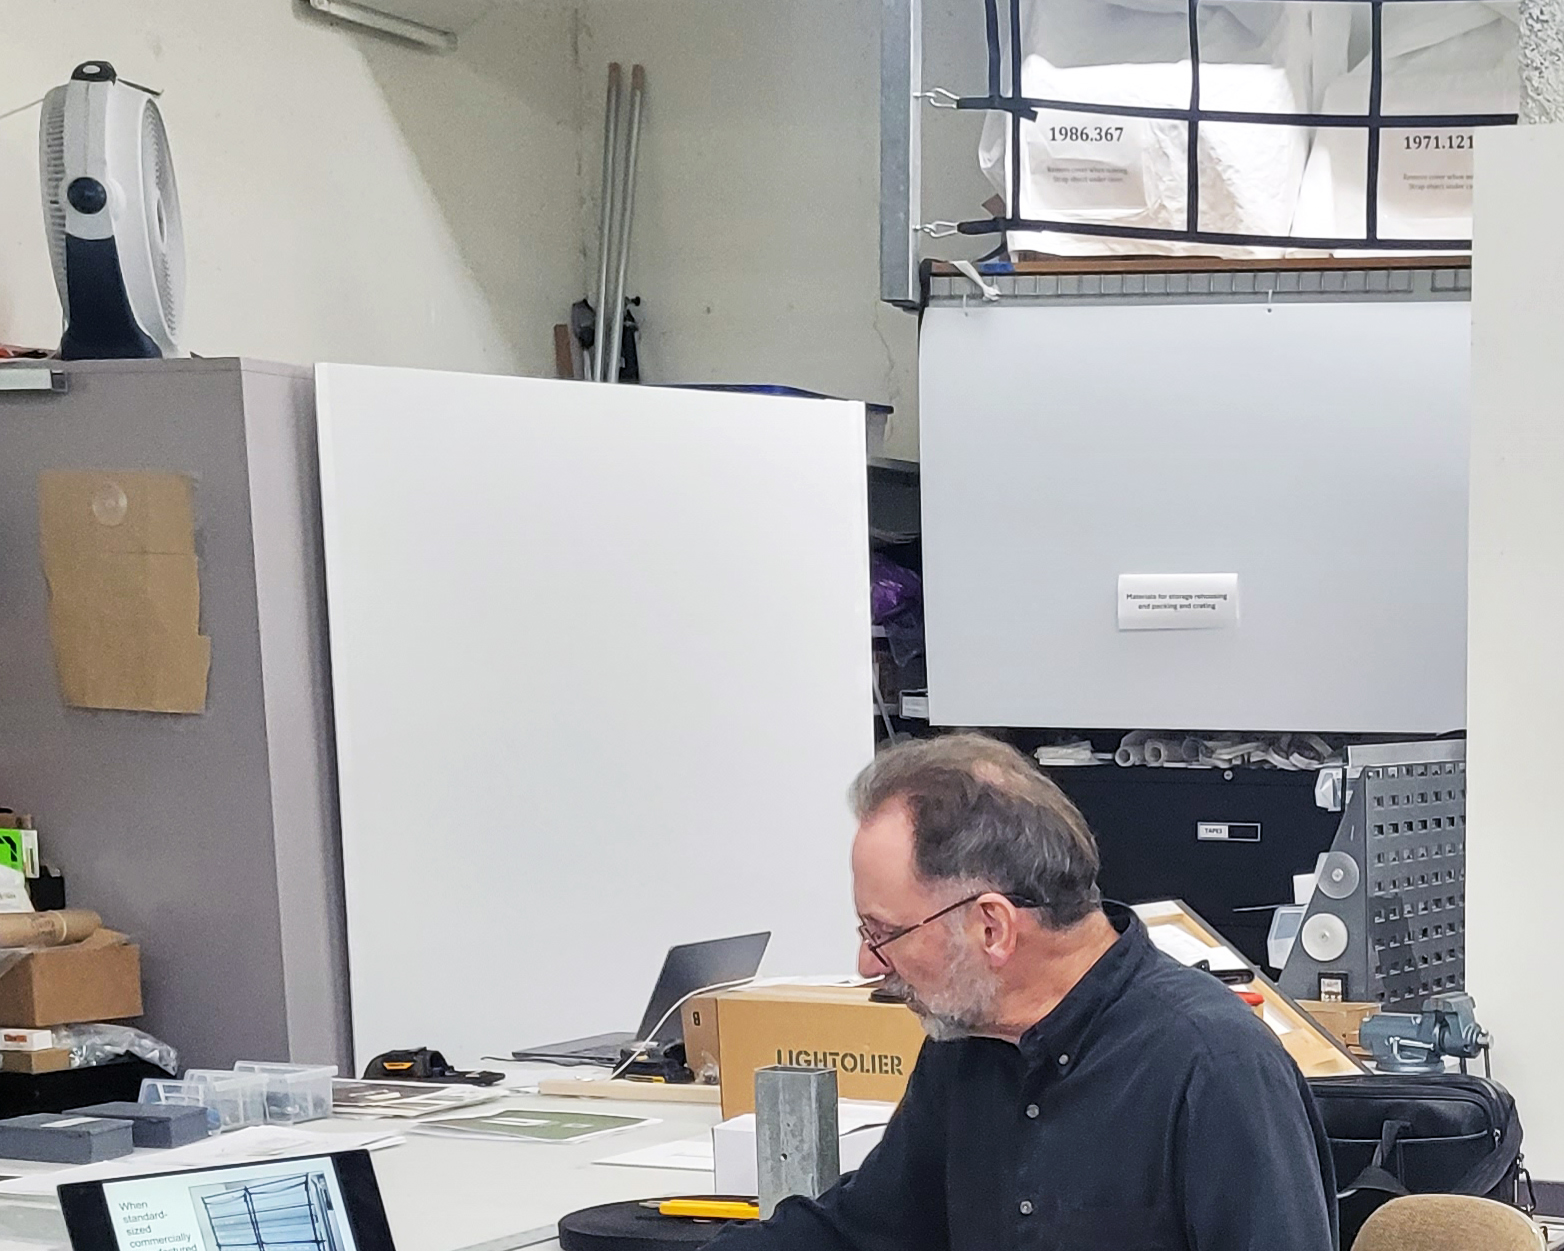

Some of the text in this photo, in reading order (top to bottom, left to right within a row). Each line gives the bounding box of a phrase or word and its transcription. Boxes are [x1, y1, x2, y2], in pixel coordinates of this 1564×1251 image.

[1049, 127, 1124, 142] 1986.367
[1404, 134, 1473, 150] 1971.121
[776, 1049, 903, 1075] LIGHTOLIER
[119, 1201, 148, 1211] When
[126, 1225, 152, 1236] sized
[130, 1233, 191, 1248] commercially
